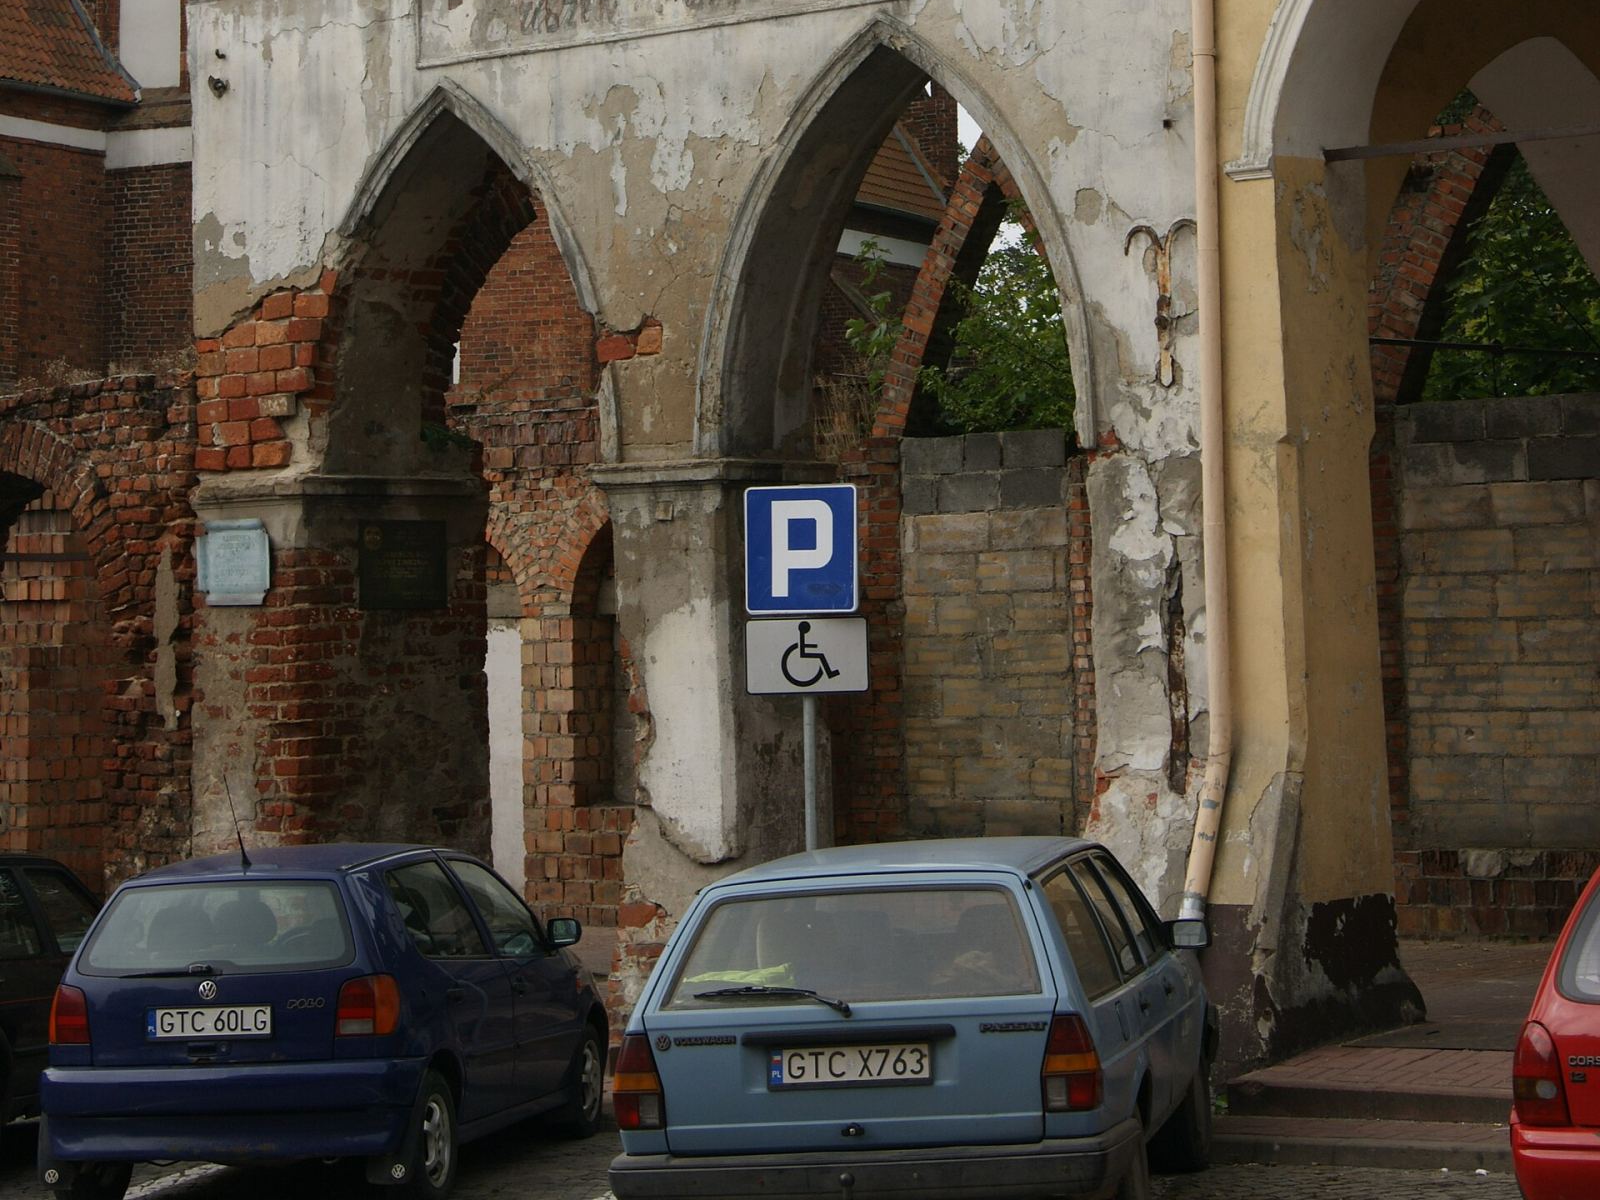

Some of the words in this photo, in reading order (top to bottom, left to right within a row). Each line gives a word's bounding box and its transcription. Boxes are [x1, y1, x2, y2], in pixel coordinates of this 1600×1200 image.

[771, 499, 833, 597] P
[287, 997, 326, 1009] POLO
[160, 1011, 205, 1033] GTC
[213, 1009, 267, 1032] 60LG
[980, 1021, 1048, 1033] PASSAT
[673, 1035, 737, 1046] VOLKSWAGEN
[772, 1070, 781, 1078] PL
[787, 1051, 846, 1079] GTC
[858, 1048, 925, 1077] X763
